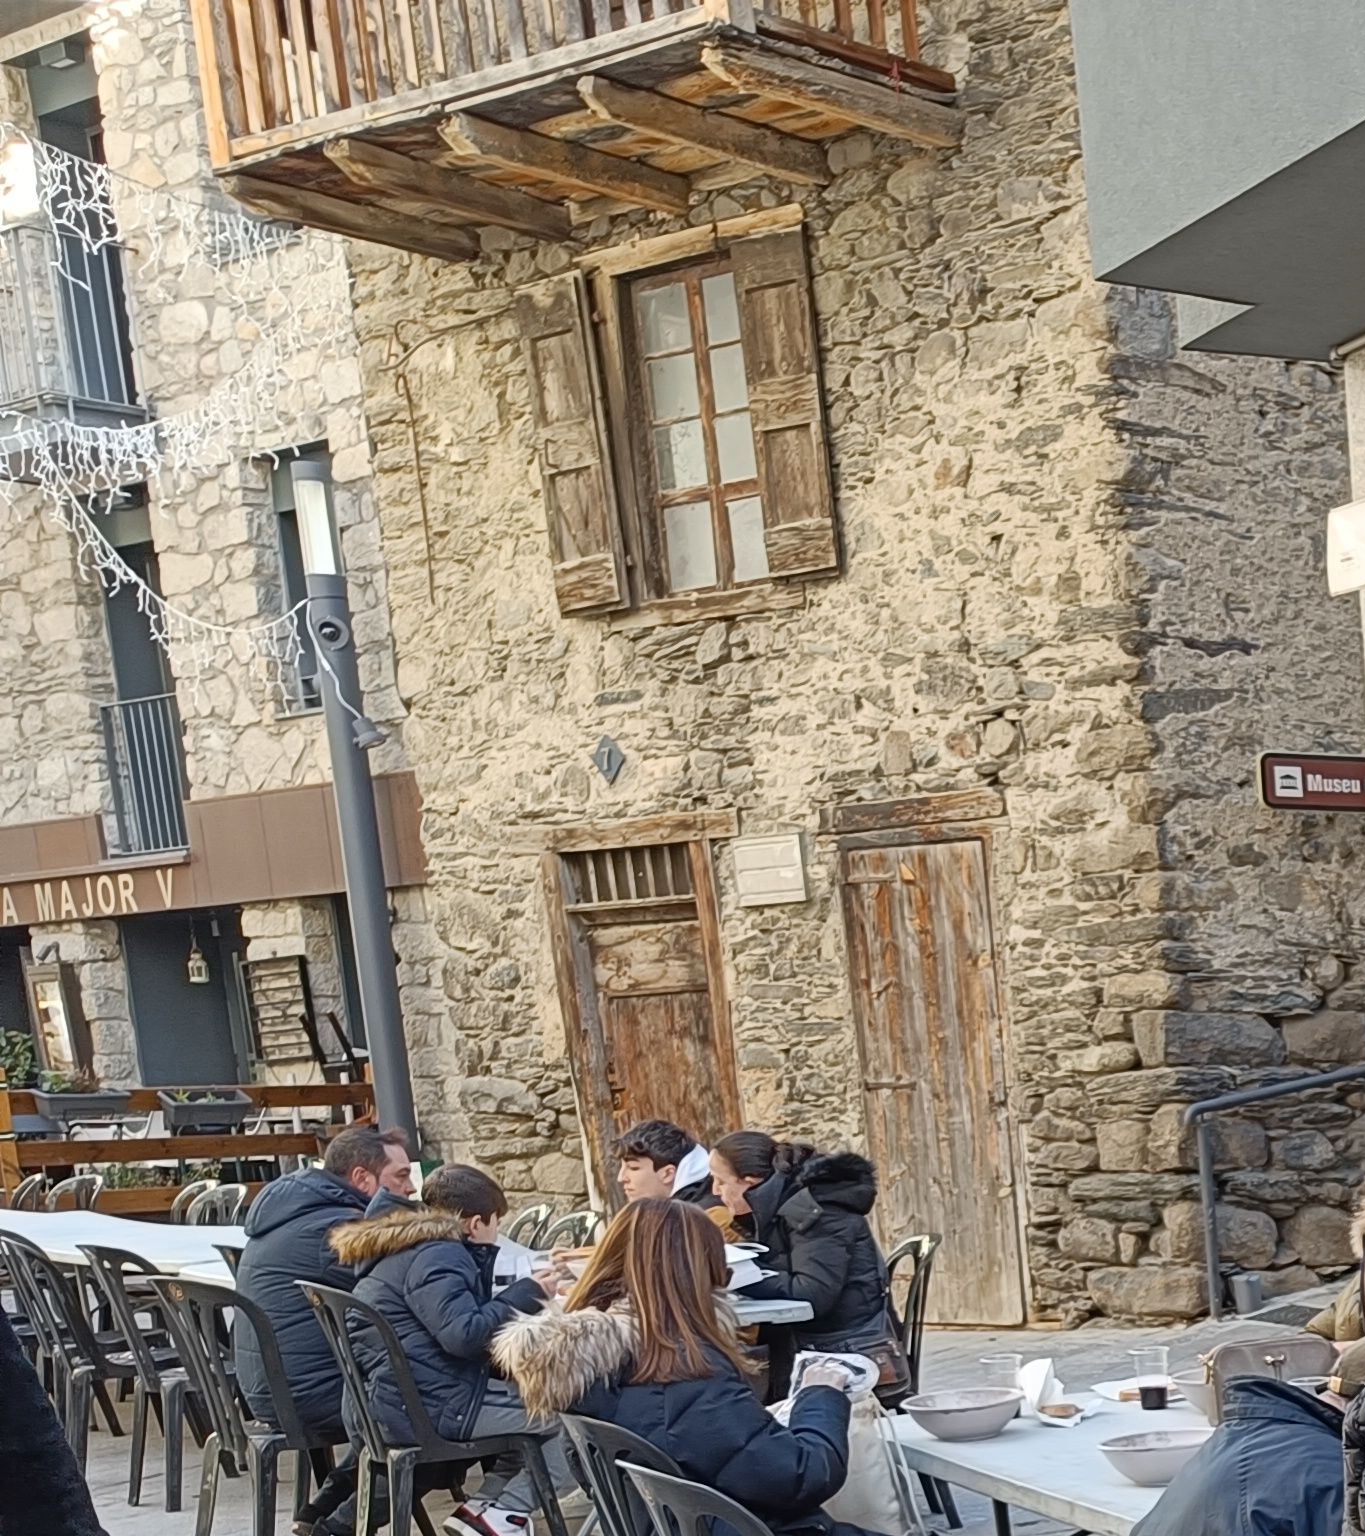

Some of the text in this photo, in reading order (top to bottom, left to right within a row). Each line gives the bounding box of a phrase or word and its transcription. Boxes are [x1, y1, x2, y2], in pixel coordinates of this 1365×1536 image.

[601, 747, 612, 772] 7
[1306, 774, 1361, 794] Museu
[34, 873, 138, 923] MAJOR
[155, 868, 173, 909] V
